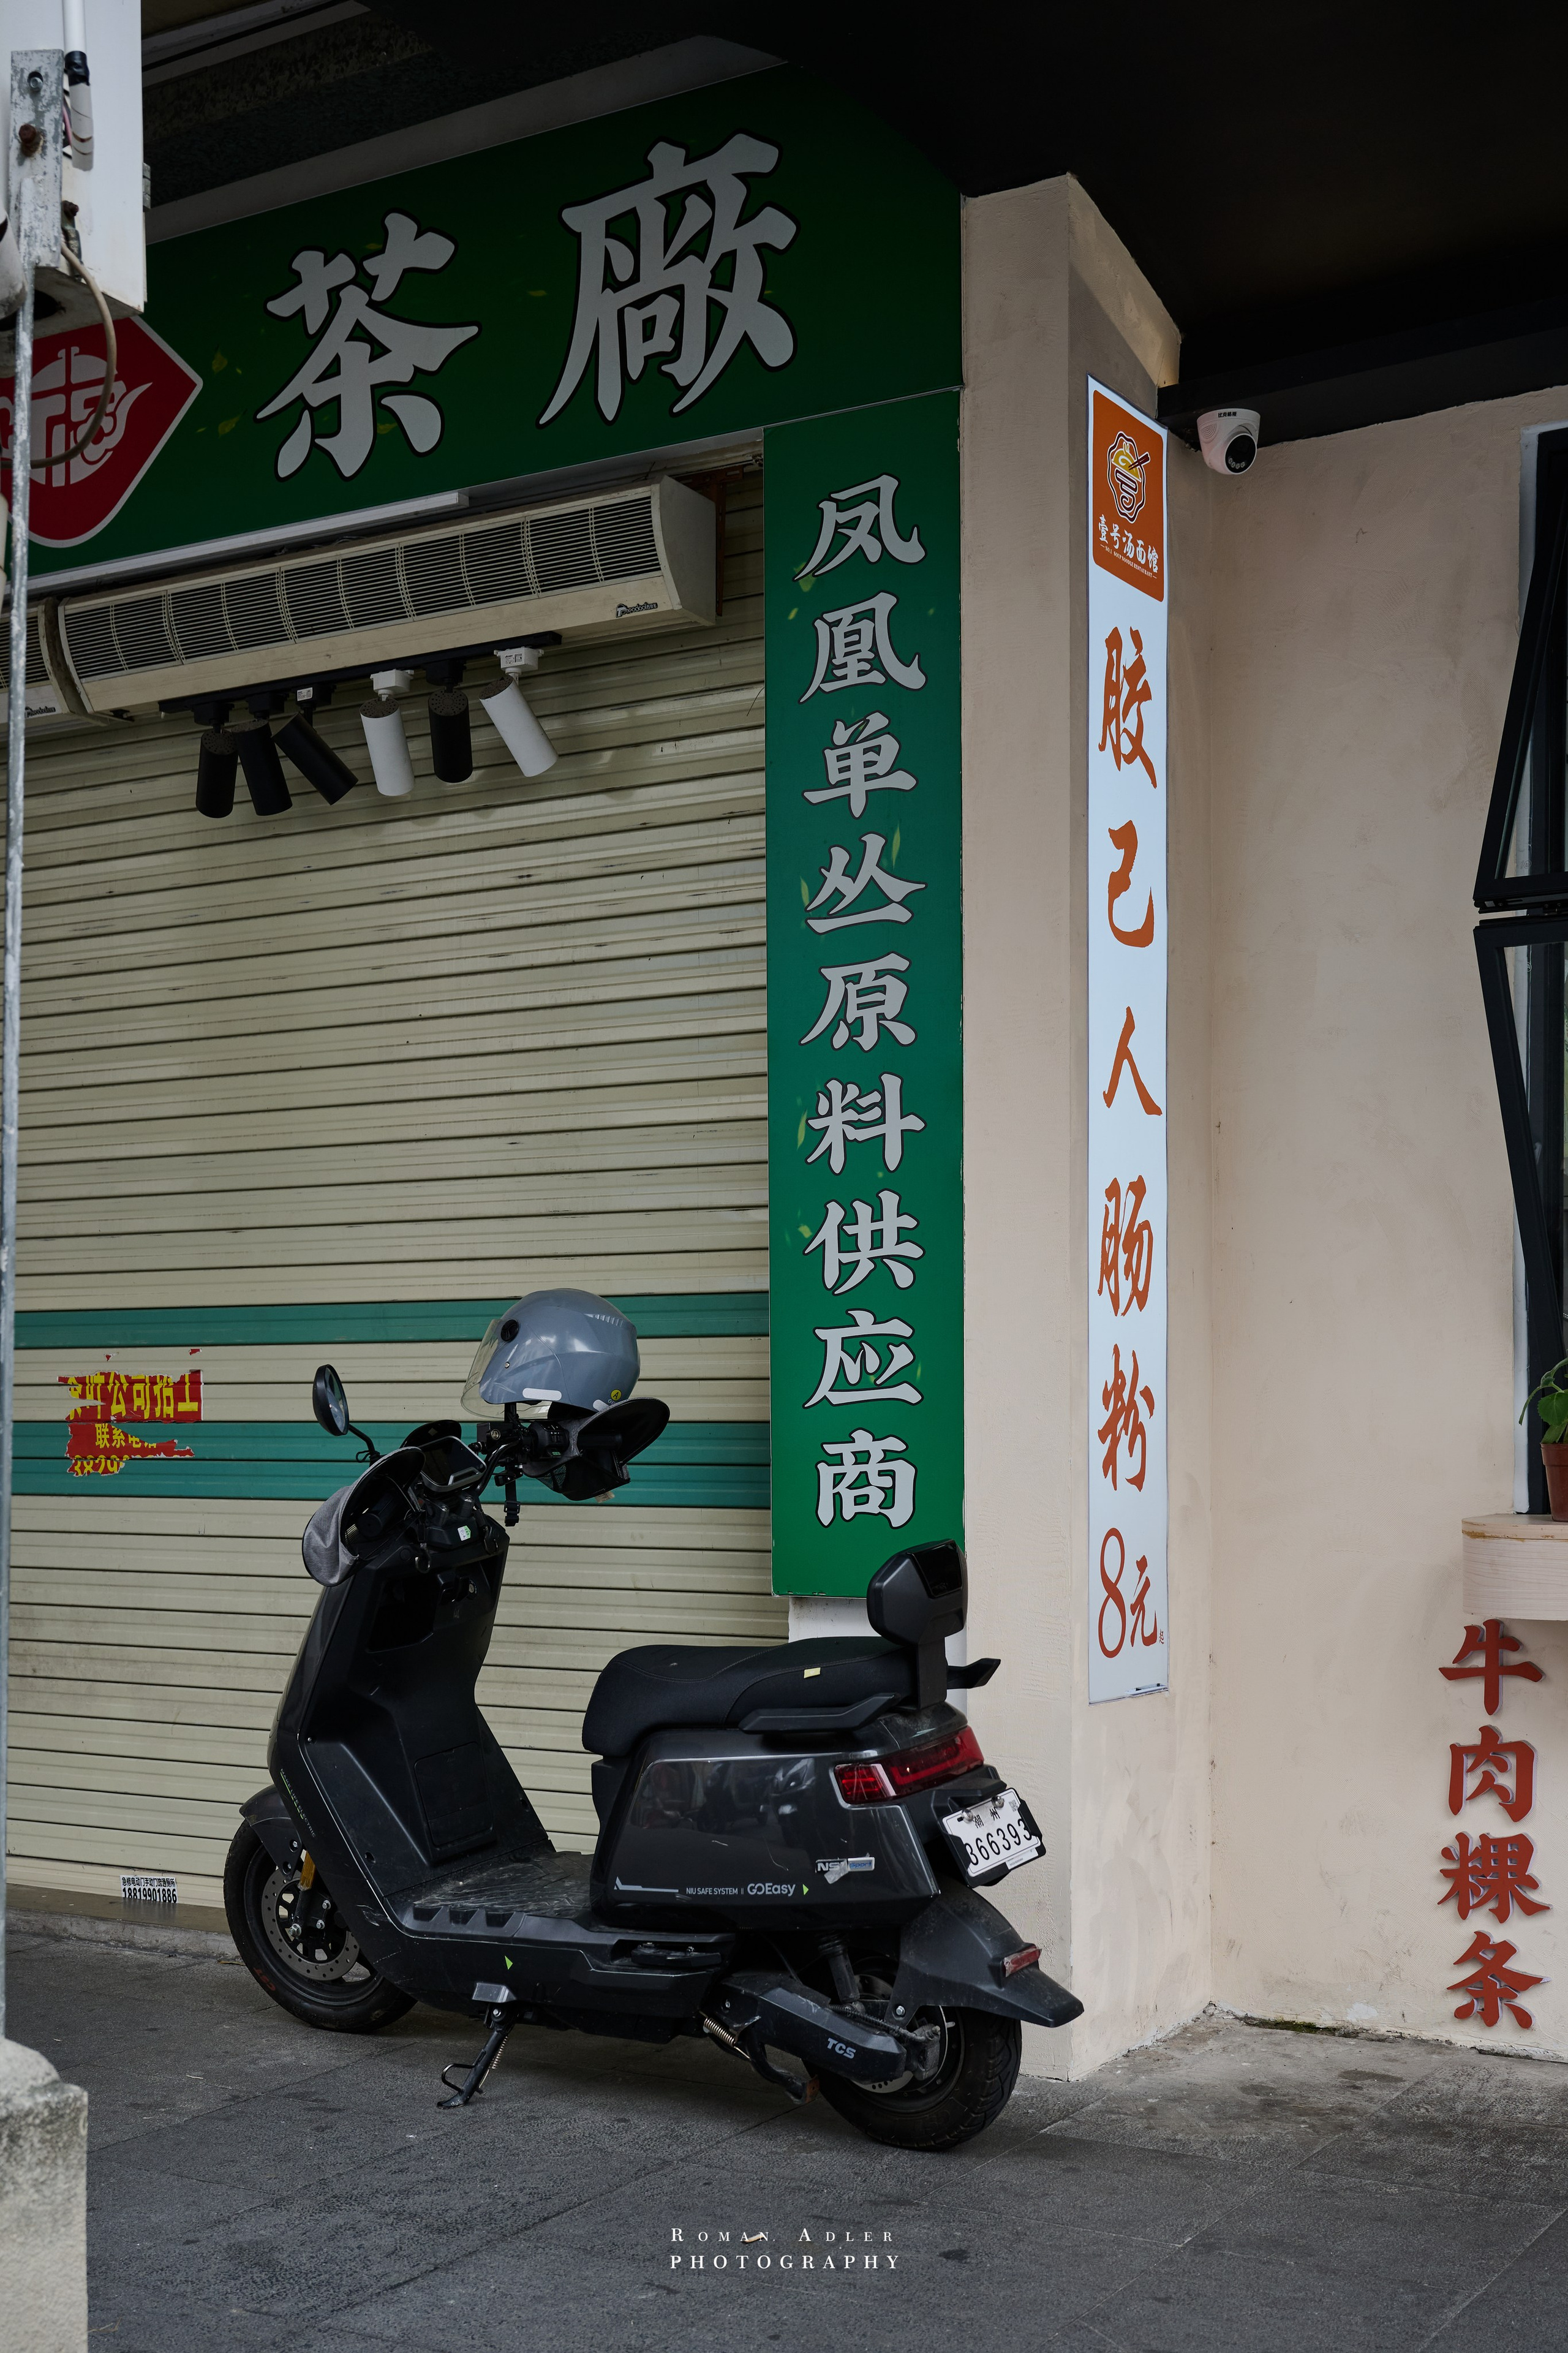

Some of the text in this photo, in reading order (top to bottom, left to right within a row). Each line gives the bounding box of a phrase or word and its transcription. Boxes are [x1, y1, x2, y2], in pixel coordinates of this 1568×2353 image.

[1099, 514, 1158, 573] 壹号汤面馆
[1121, 556, 1133, 567] NOODLE
[1134, 562, 1153, 578] RESTAURANT
[794, 474, 927, 1529] 凤凰单丛原料供应商
[281, 1769, 315, 1838] MAKE LIFE ELECTRIC
[973, 1807, 1000, 1829] 潮州
[1437, 1618, 1553, 2030] 牛肉粿条
[965, 1818, 1032, 1866] 366393
[123, 1887, 177, 1903] 18819901886
[827, 2038, 856, 2059] TCS
